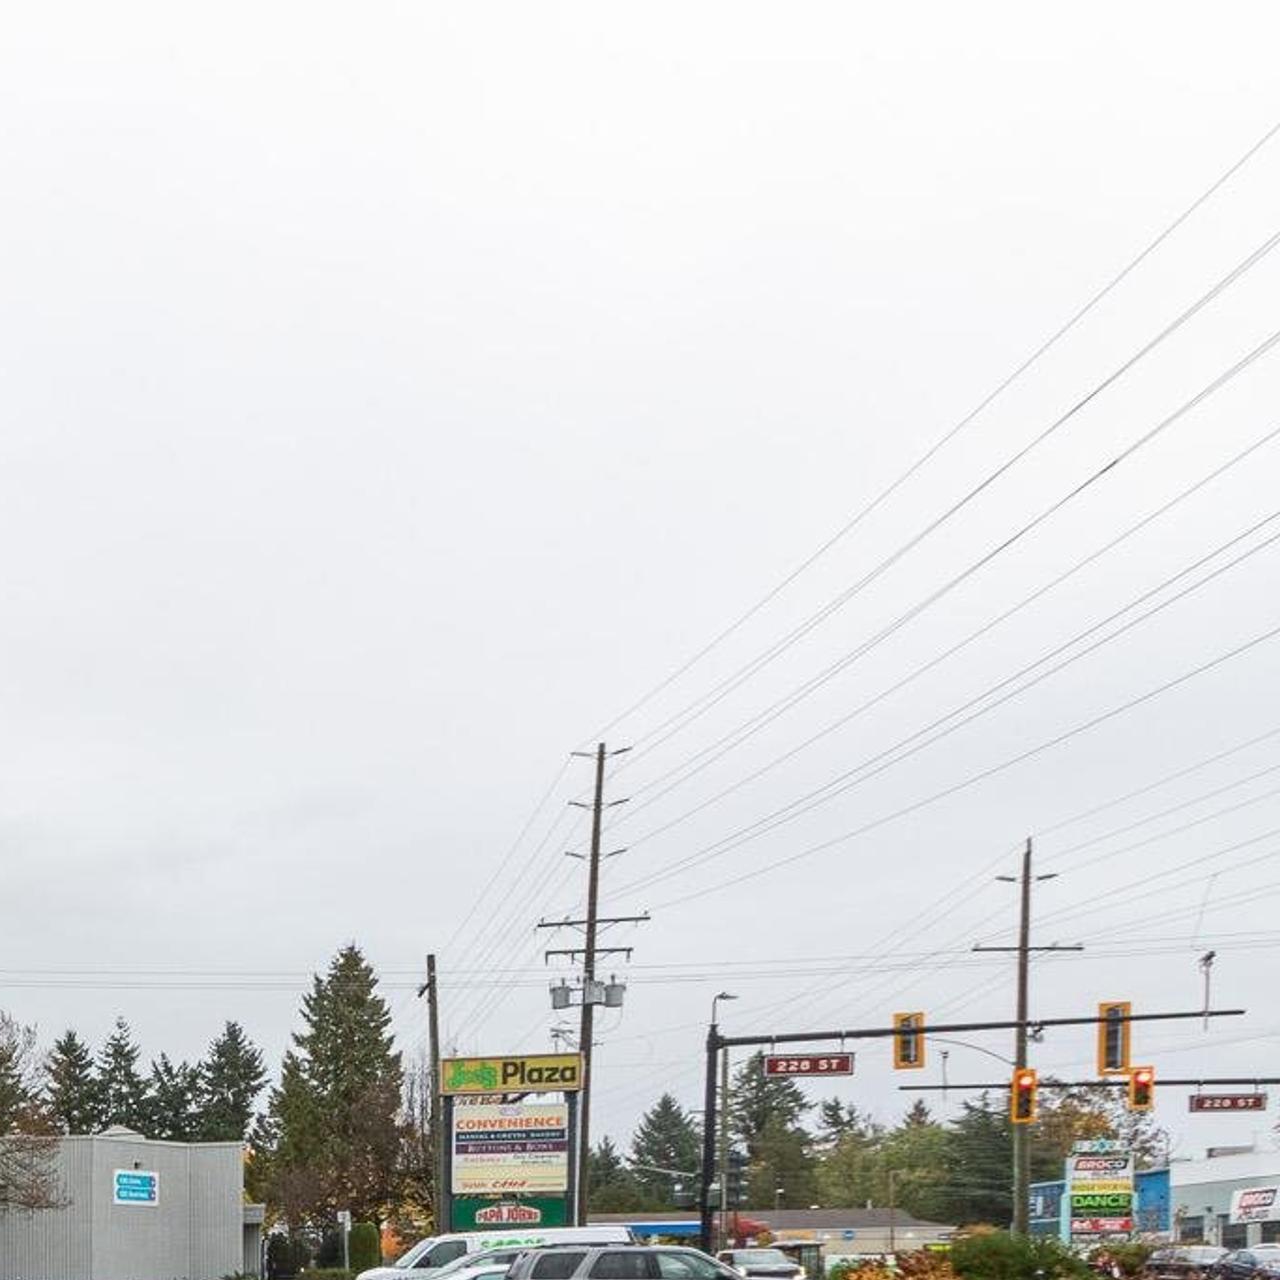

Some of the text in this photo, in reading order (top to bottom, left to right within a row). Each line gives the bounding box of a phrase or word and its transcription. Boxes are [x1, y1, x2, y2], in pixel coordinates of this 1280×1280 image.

[776, 1059, 840, 1072] 228 ST
[501, 1061, 577, 1085] Plaza
[455, 1115, 563, 1130] CONVENIENCE
[1071, 1196, 1130, 1207] DANCE
